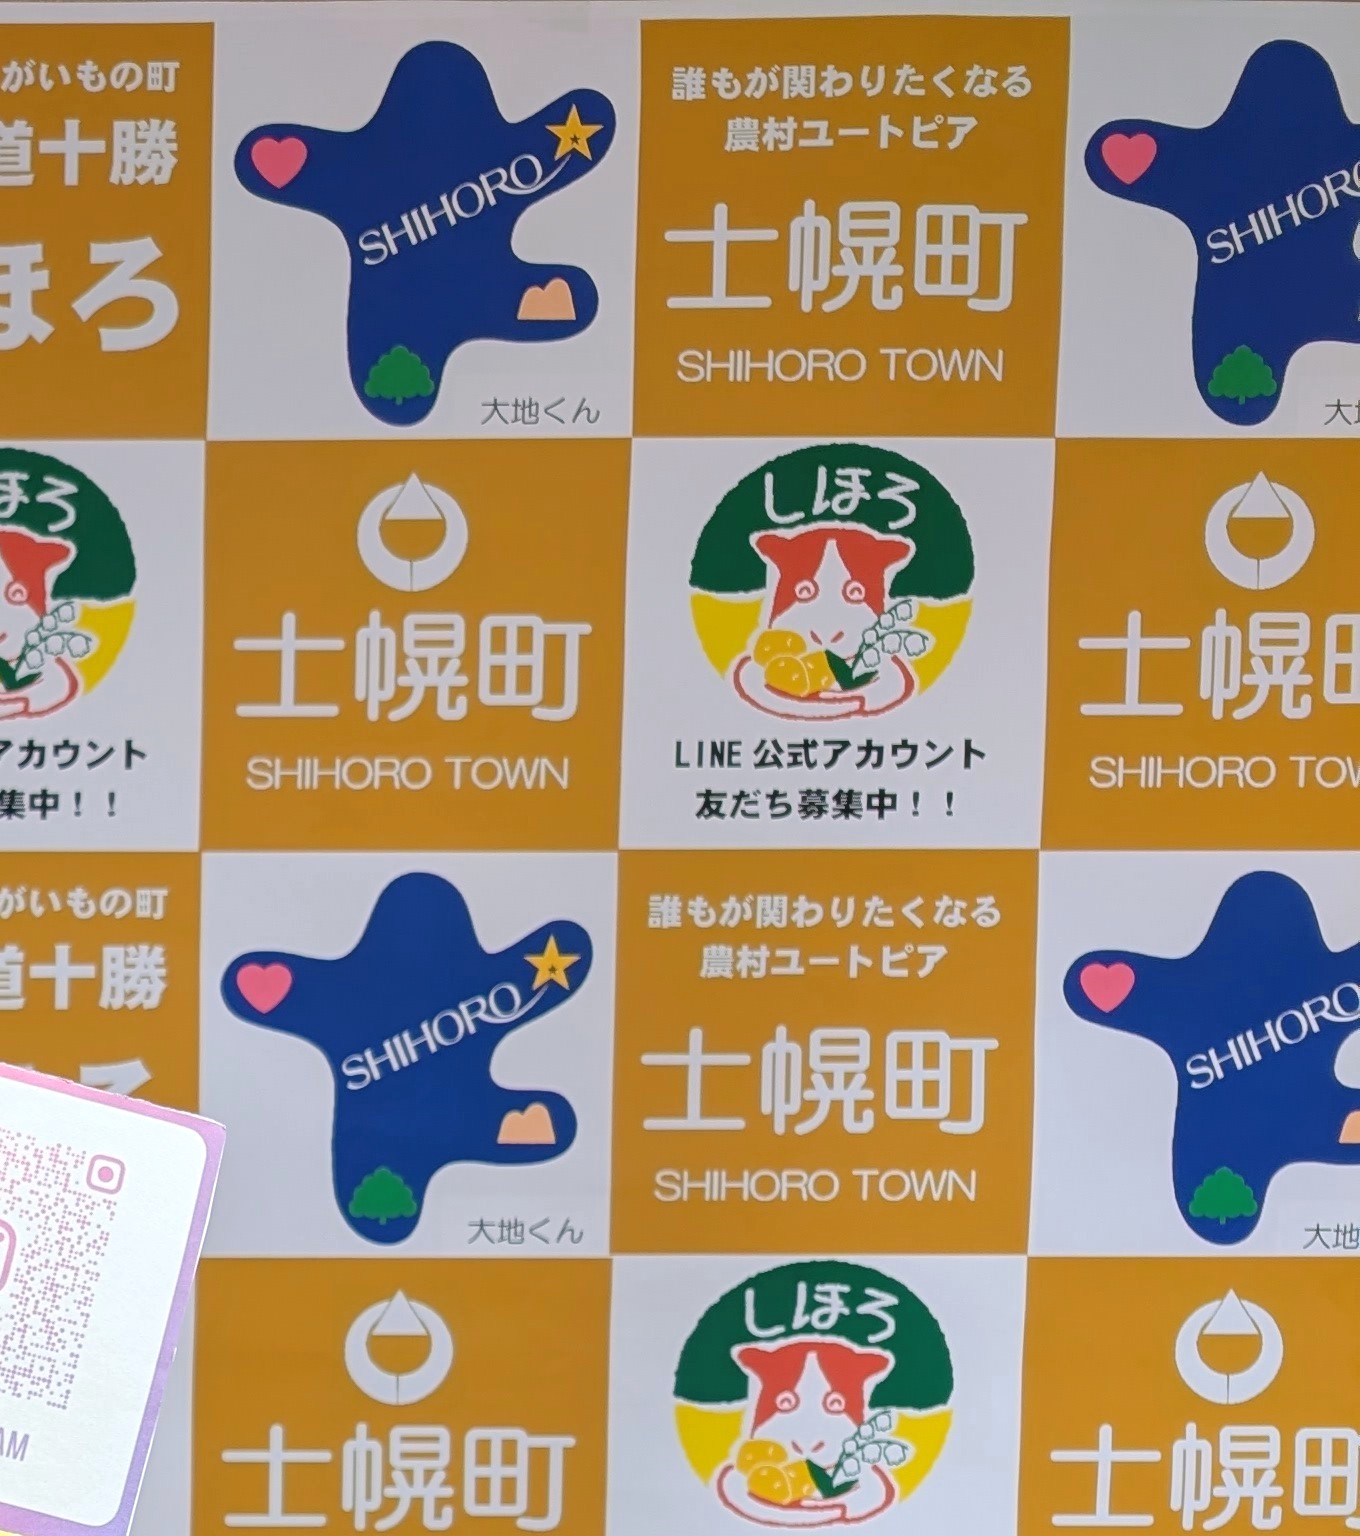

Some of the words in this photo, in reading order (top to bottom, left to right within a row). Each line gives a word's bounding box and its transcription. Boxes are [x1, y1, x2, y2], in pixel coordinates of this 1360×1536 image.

[672, 64, 1031, 101] 誰もが関わりたくなる
[725, 115, 977, 151] 農村ユートピア
[358, 154, 543, 267] SHIHORO
[1206, 160, 1360, 265] SHIHOR
[664, 199, 1028, 312] 士幌町
[677, 349, 866, 382] SHIHORO
[880, 348, 1003, 381] TOWN
[482, 397, 600, 424] 大地くん
[762, 464, 921, 532] しほろ
[234, 609, 592, 721] 士幌町
[676, 741, 741, 767] LINE
[754, 739, 985, 769] 公式アカウント
[1090, 756, 1276, 788] SHIHORO
[247, 756, 432, 790] SHIHORO
[445, 756, 568, 789] TOWN
[696, 789, 953, 819] 友だち募集中！！
[648, 895, 1000, 928] 誰もが関わりたくなる
[700, 944, 947, 978] 農村ユートピア
[340, 983, 522, 1093] SHIHORO
[1186, 982, 1360, 1091] SHIHORO
[641, 1025, 999, 1135] 士幌町
[654, 1169, 840, 1201] SHIHORO
[852, 1169, 976, 1201] TOWN
[469, 1218, 583, 1244] 大地くん
[1303, 1223, 1360, 1249] 大地
[744, 1281, 900, 1345] しほろ
[222, 1422, 576, 1531] 士幌町
